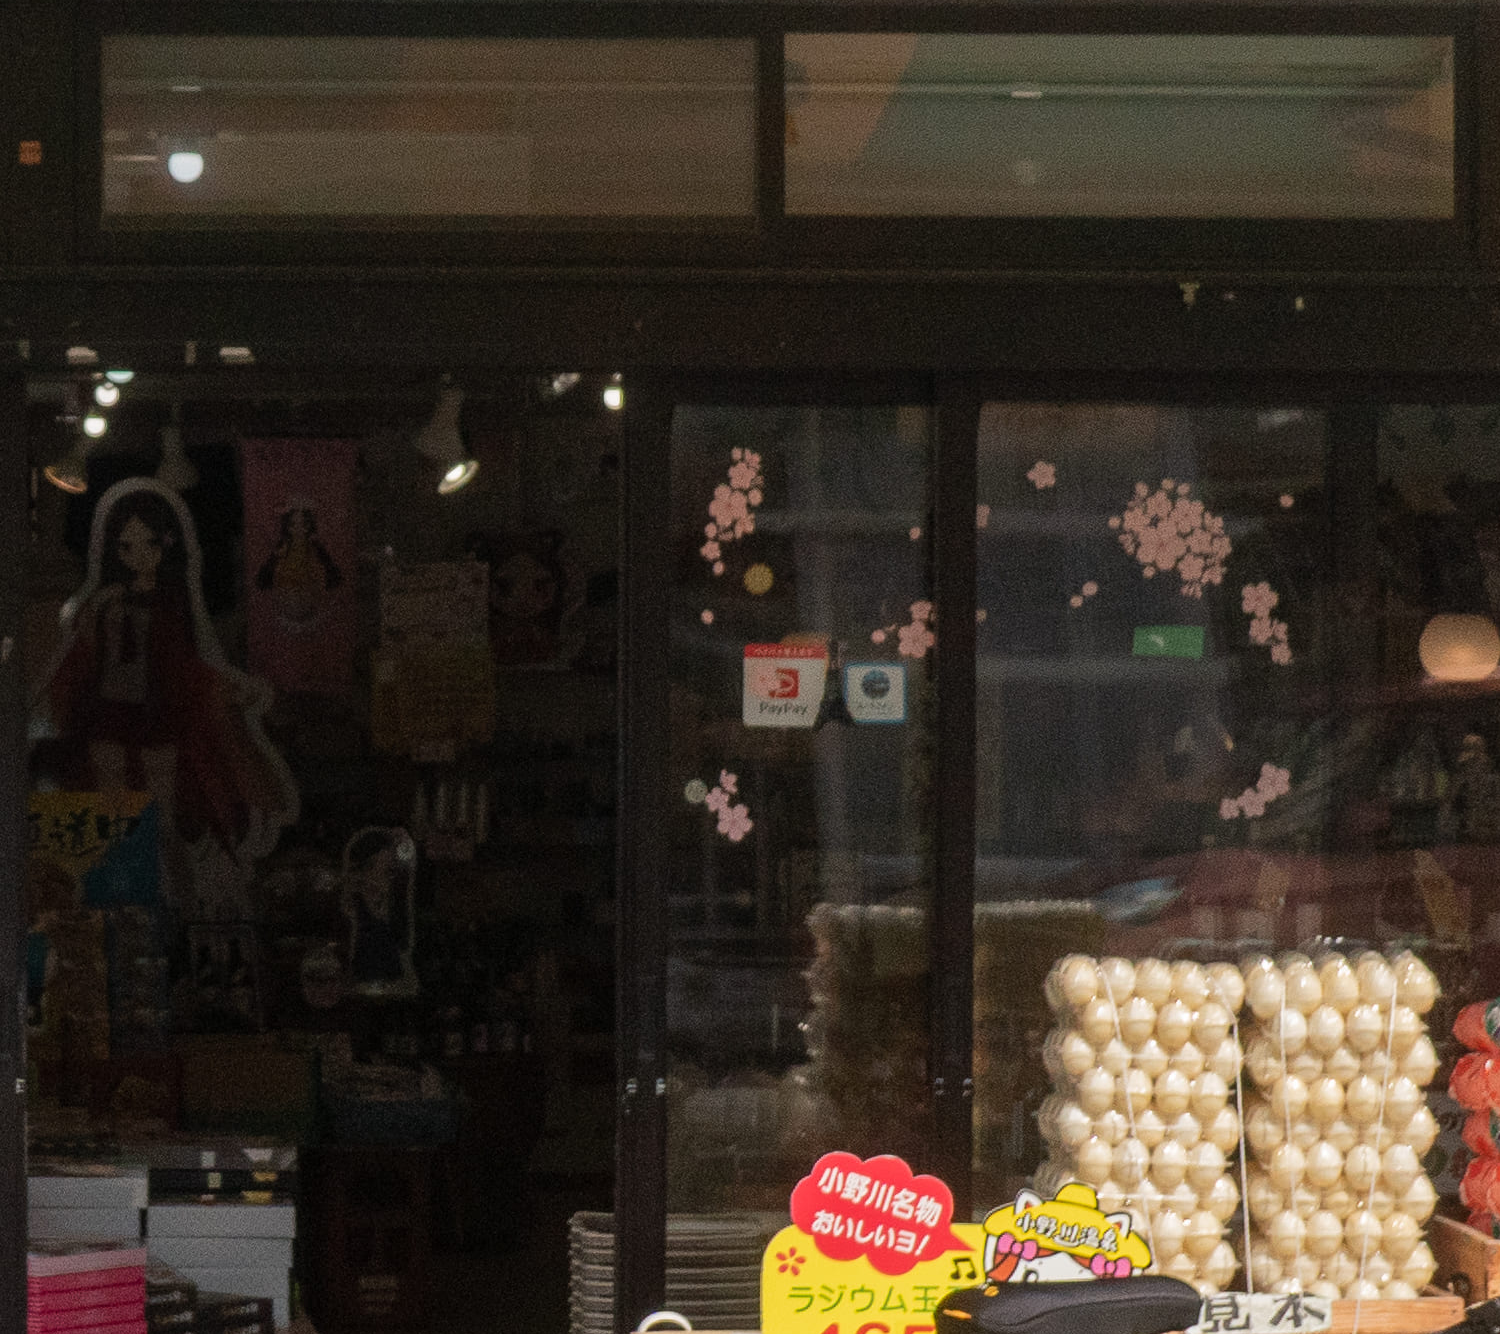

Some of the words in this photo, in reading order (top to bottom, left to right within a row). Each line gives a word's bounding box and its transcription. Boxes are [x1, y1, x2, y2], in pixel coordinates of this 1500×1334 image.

[759, 702, 808, 716] PayPay
[817, 1164, 943, 1228] 小野川名物
[1014, 1210, 1119, 1253] 小野川温泉
[787, 1283, 960, 1314] ラジウム玉
[1202, 1292, 1327, 1332] 見本
